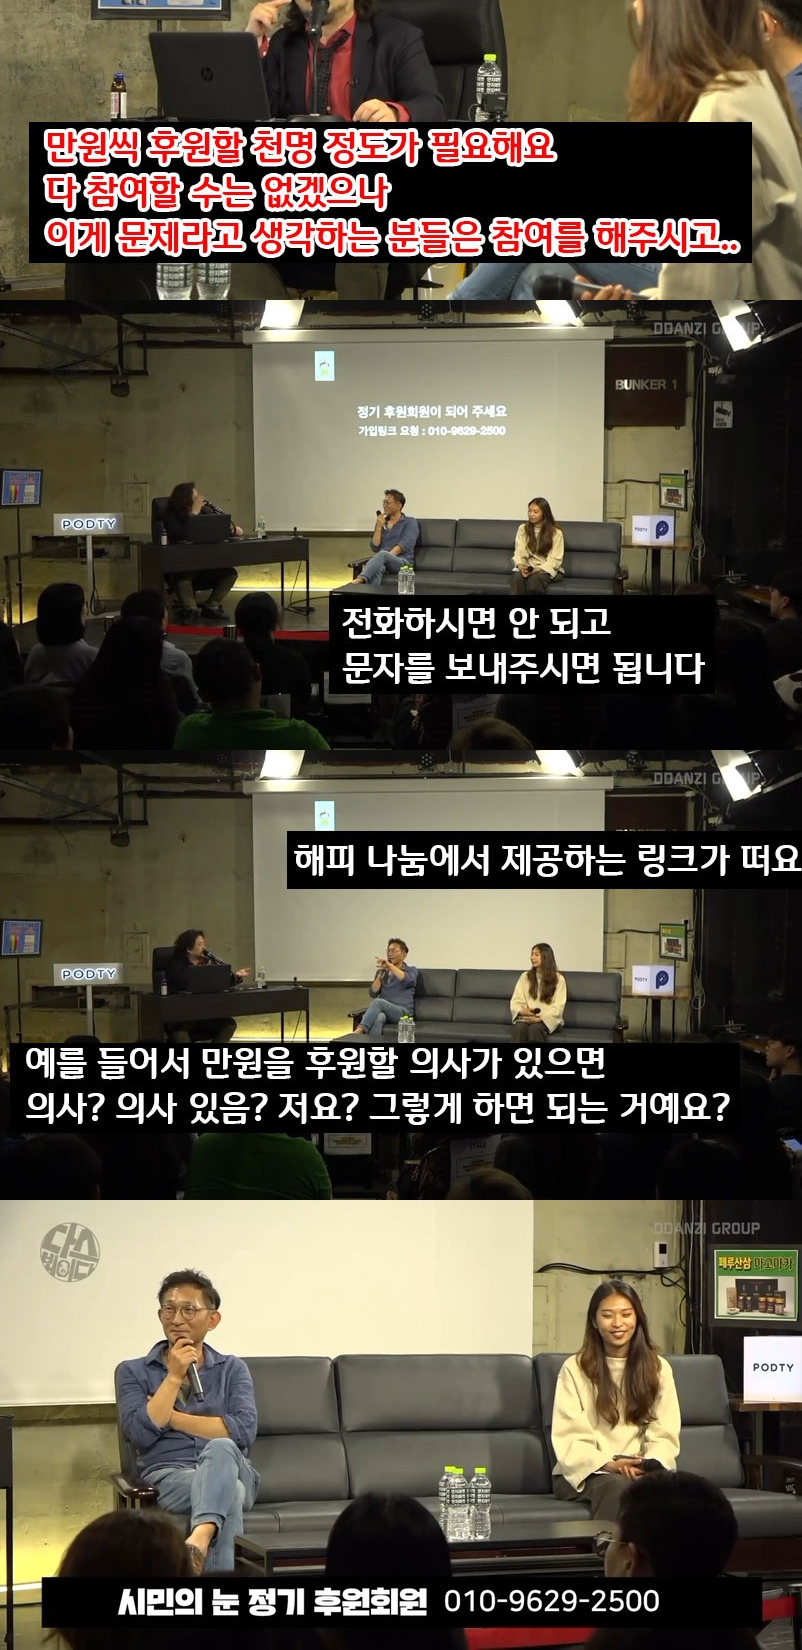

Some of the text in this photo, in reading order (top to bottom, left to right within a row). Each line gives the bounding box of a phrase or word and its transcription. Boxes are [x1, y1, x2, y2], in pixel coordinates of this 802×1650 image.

[357, 405, 507, 419] 정기 후원회원이 되어 주세요
[358, 425, 397, 436] 가입링크
[400, 425, 419, 436] 요청
[428, 426, 506, 436] 010-9629-2500
[753, 1363, 794, 1372] PODTY
